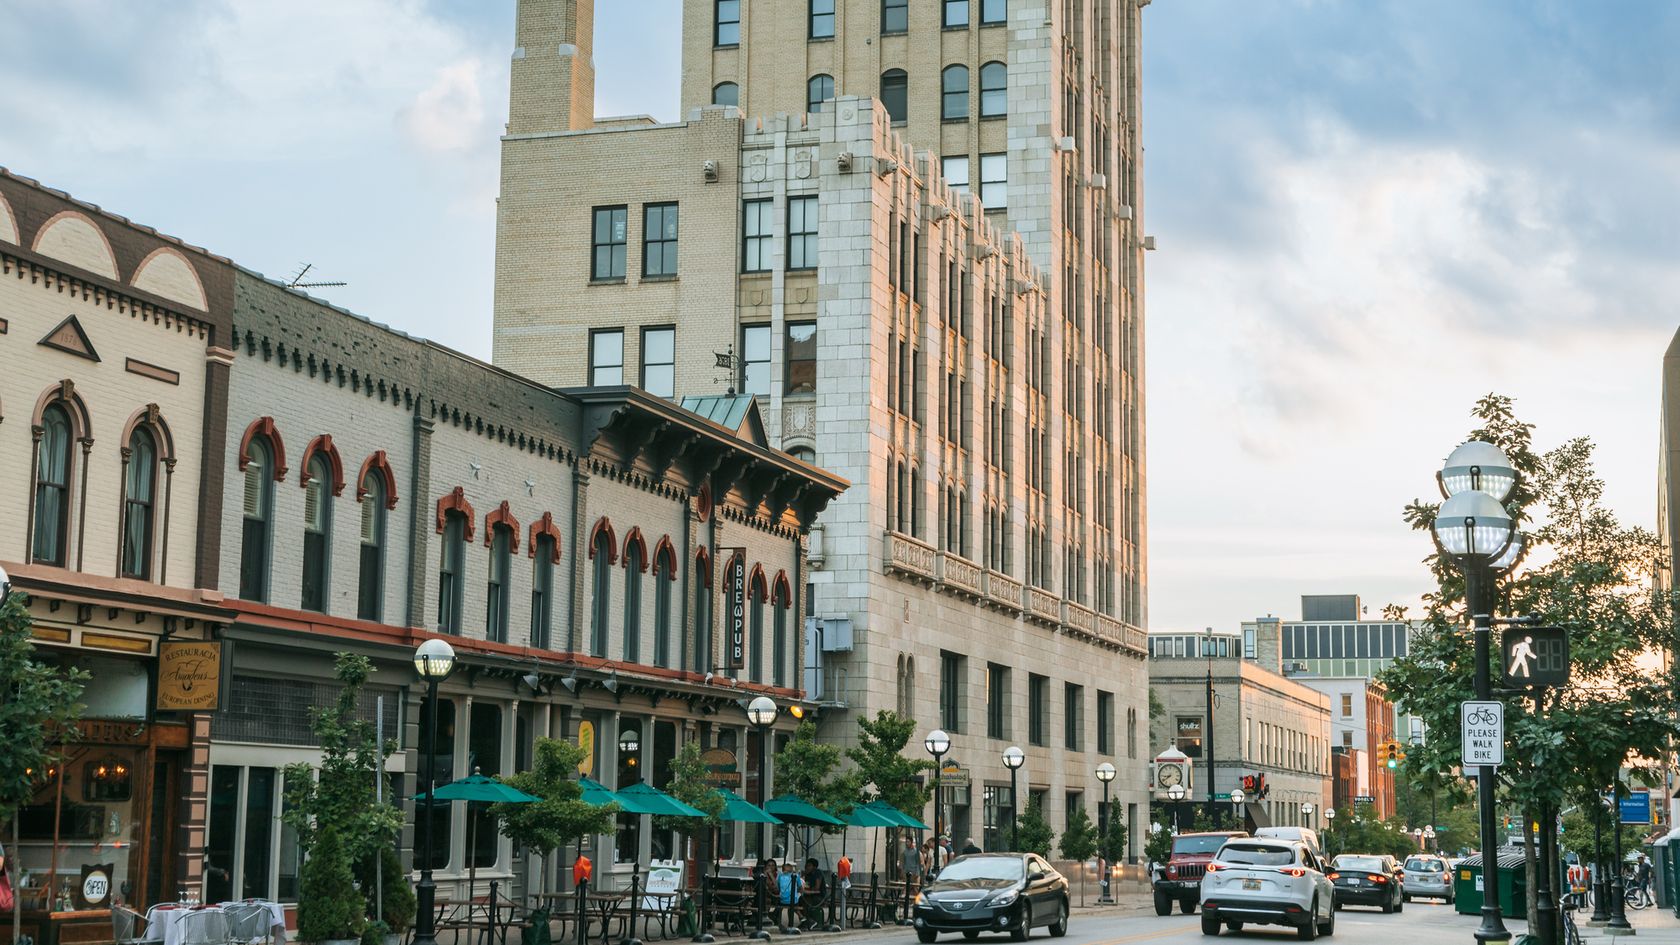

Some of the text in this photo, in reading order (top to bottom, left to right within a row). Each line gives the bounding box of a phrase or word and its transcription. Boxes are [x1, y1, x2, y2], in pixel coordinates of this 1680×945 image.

[734, 565, 743, 658] BREWPUB
[161, 692, 215, 705] EUROPEAN DINING
[1467, 729, 1497, 738] PLEASE
[1472, 740, 1493, 748] WALK
[1474, 751, 1492, 759] BIKE
[86, 880, 107, 896] OPEN
